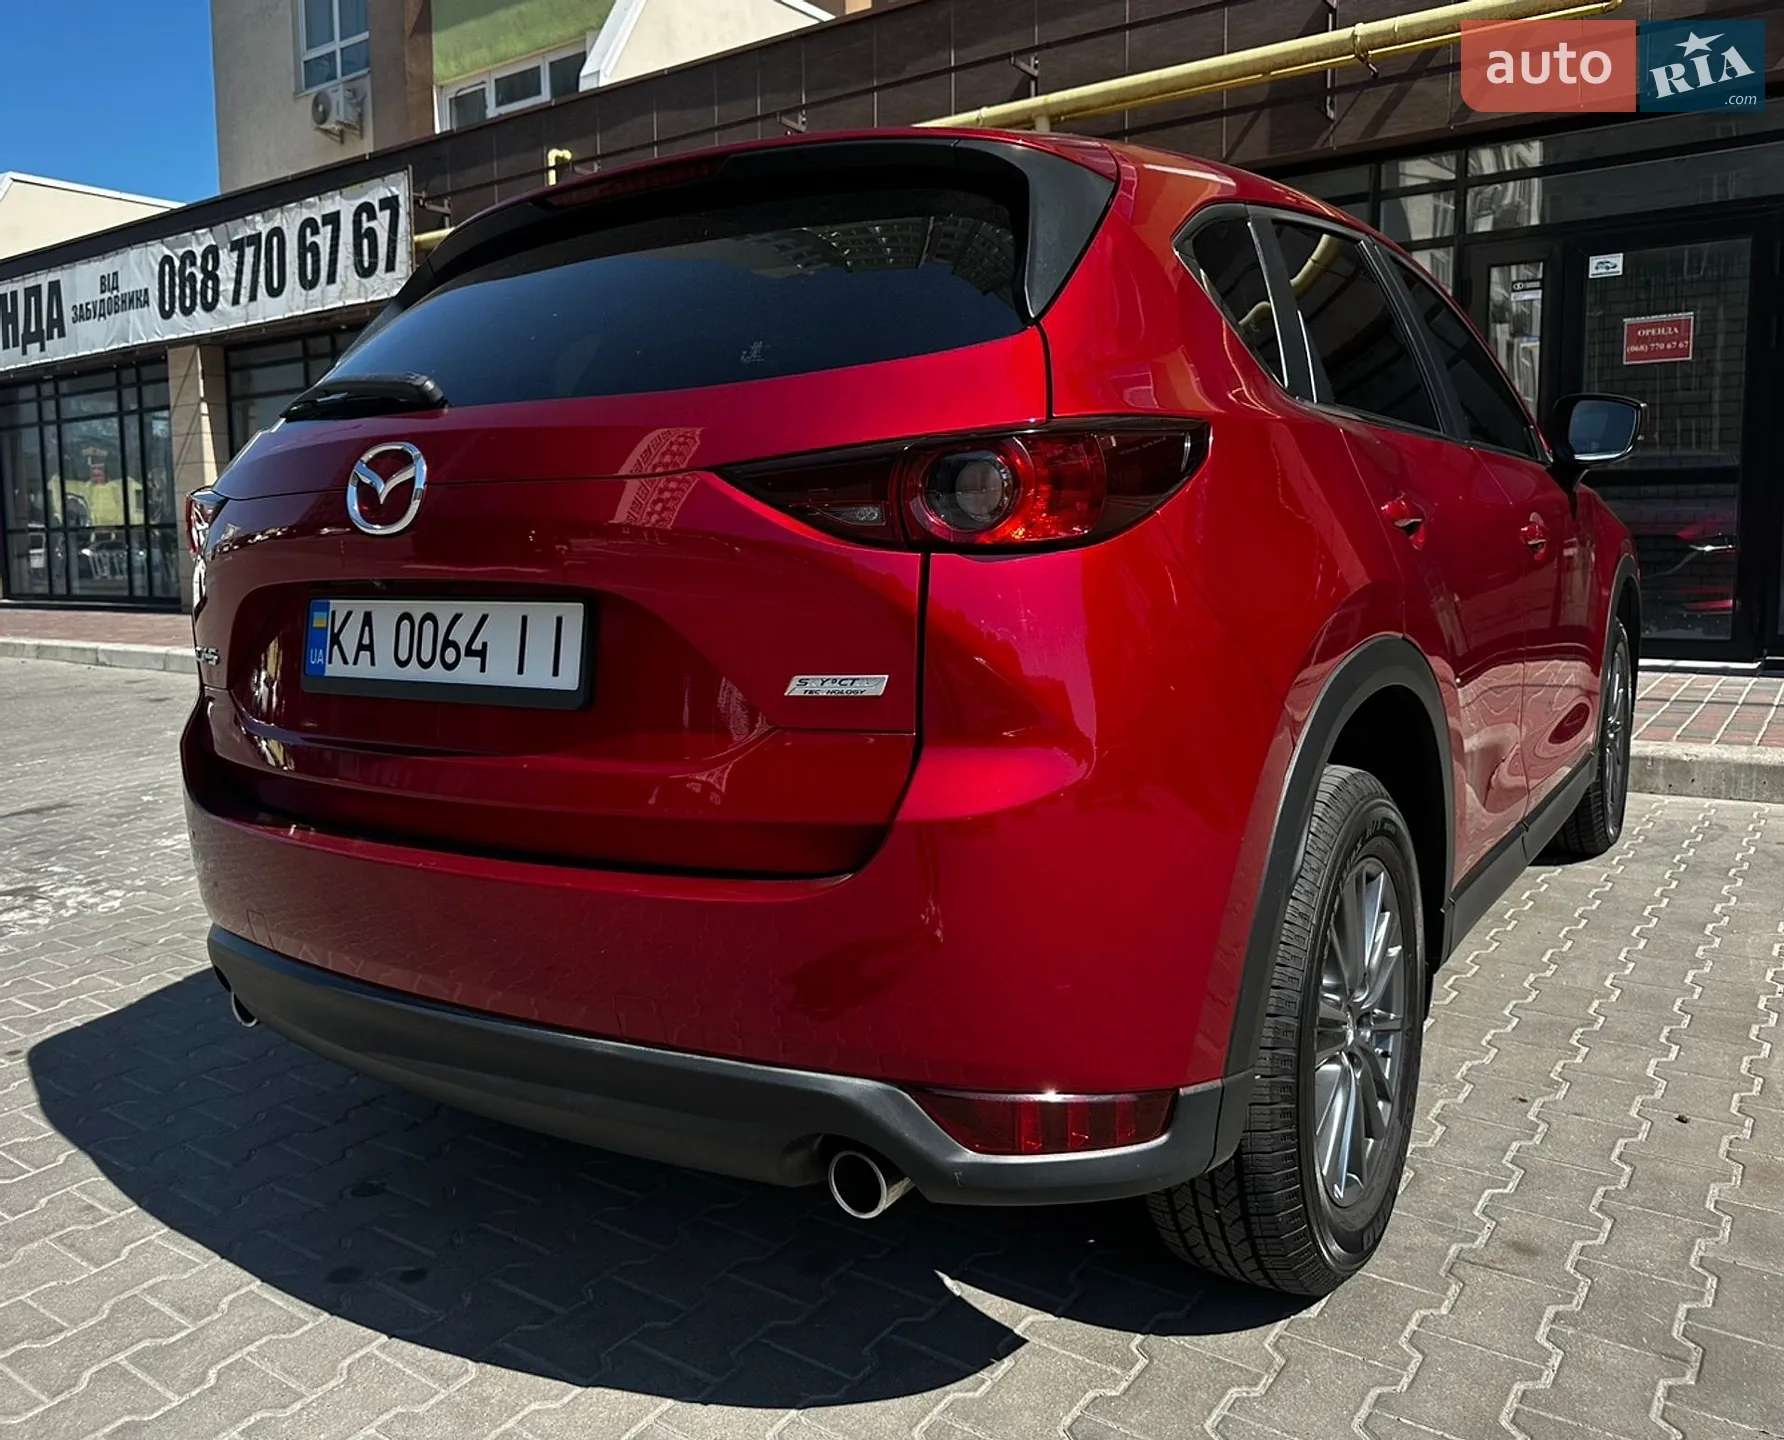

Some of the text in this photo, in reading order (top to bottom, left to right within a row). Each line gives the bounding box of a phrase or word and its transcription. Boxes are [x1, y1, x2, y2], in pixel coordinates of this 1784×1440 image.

[157, 194, 400, 320] 068 770 67 67
[100, 270, 119, 297] ВІД
[71, 288, 150, 324] ЗАБУДОВНИКА
[1637, 326, 1679, 336] ОРЕНДА
[1650, 342, 1665, 351] 770
[1666, 341, 1677, 350] 67
[1678, 340, 1689, 349] 67
[327, 609, 376, 667] KA
[393, 611, 489, 674] 0064
[310, 648, 324, 665] UA
